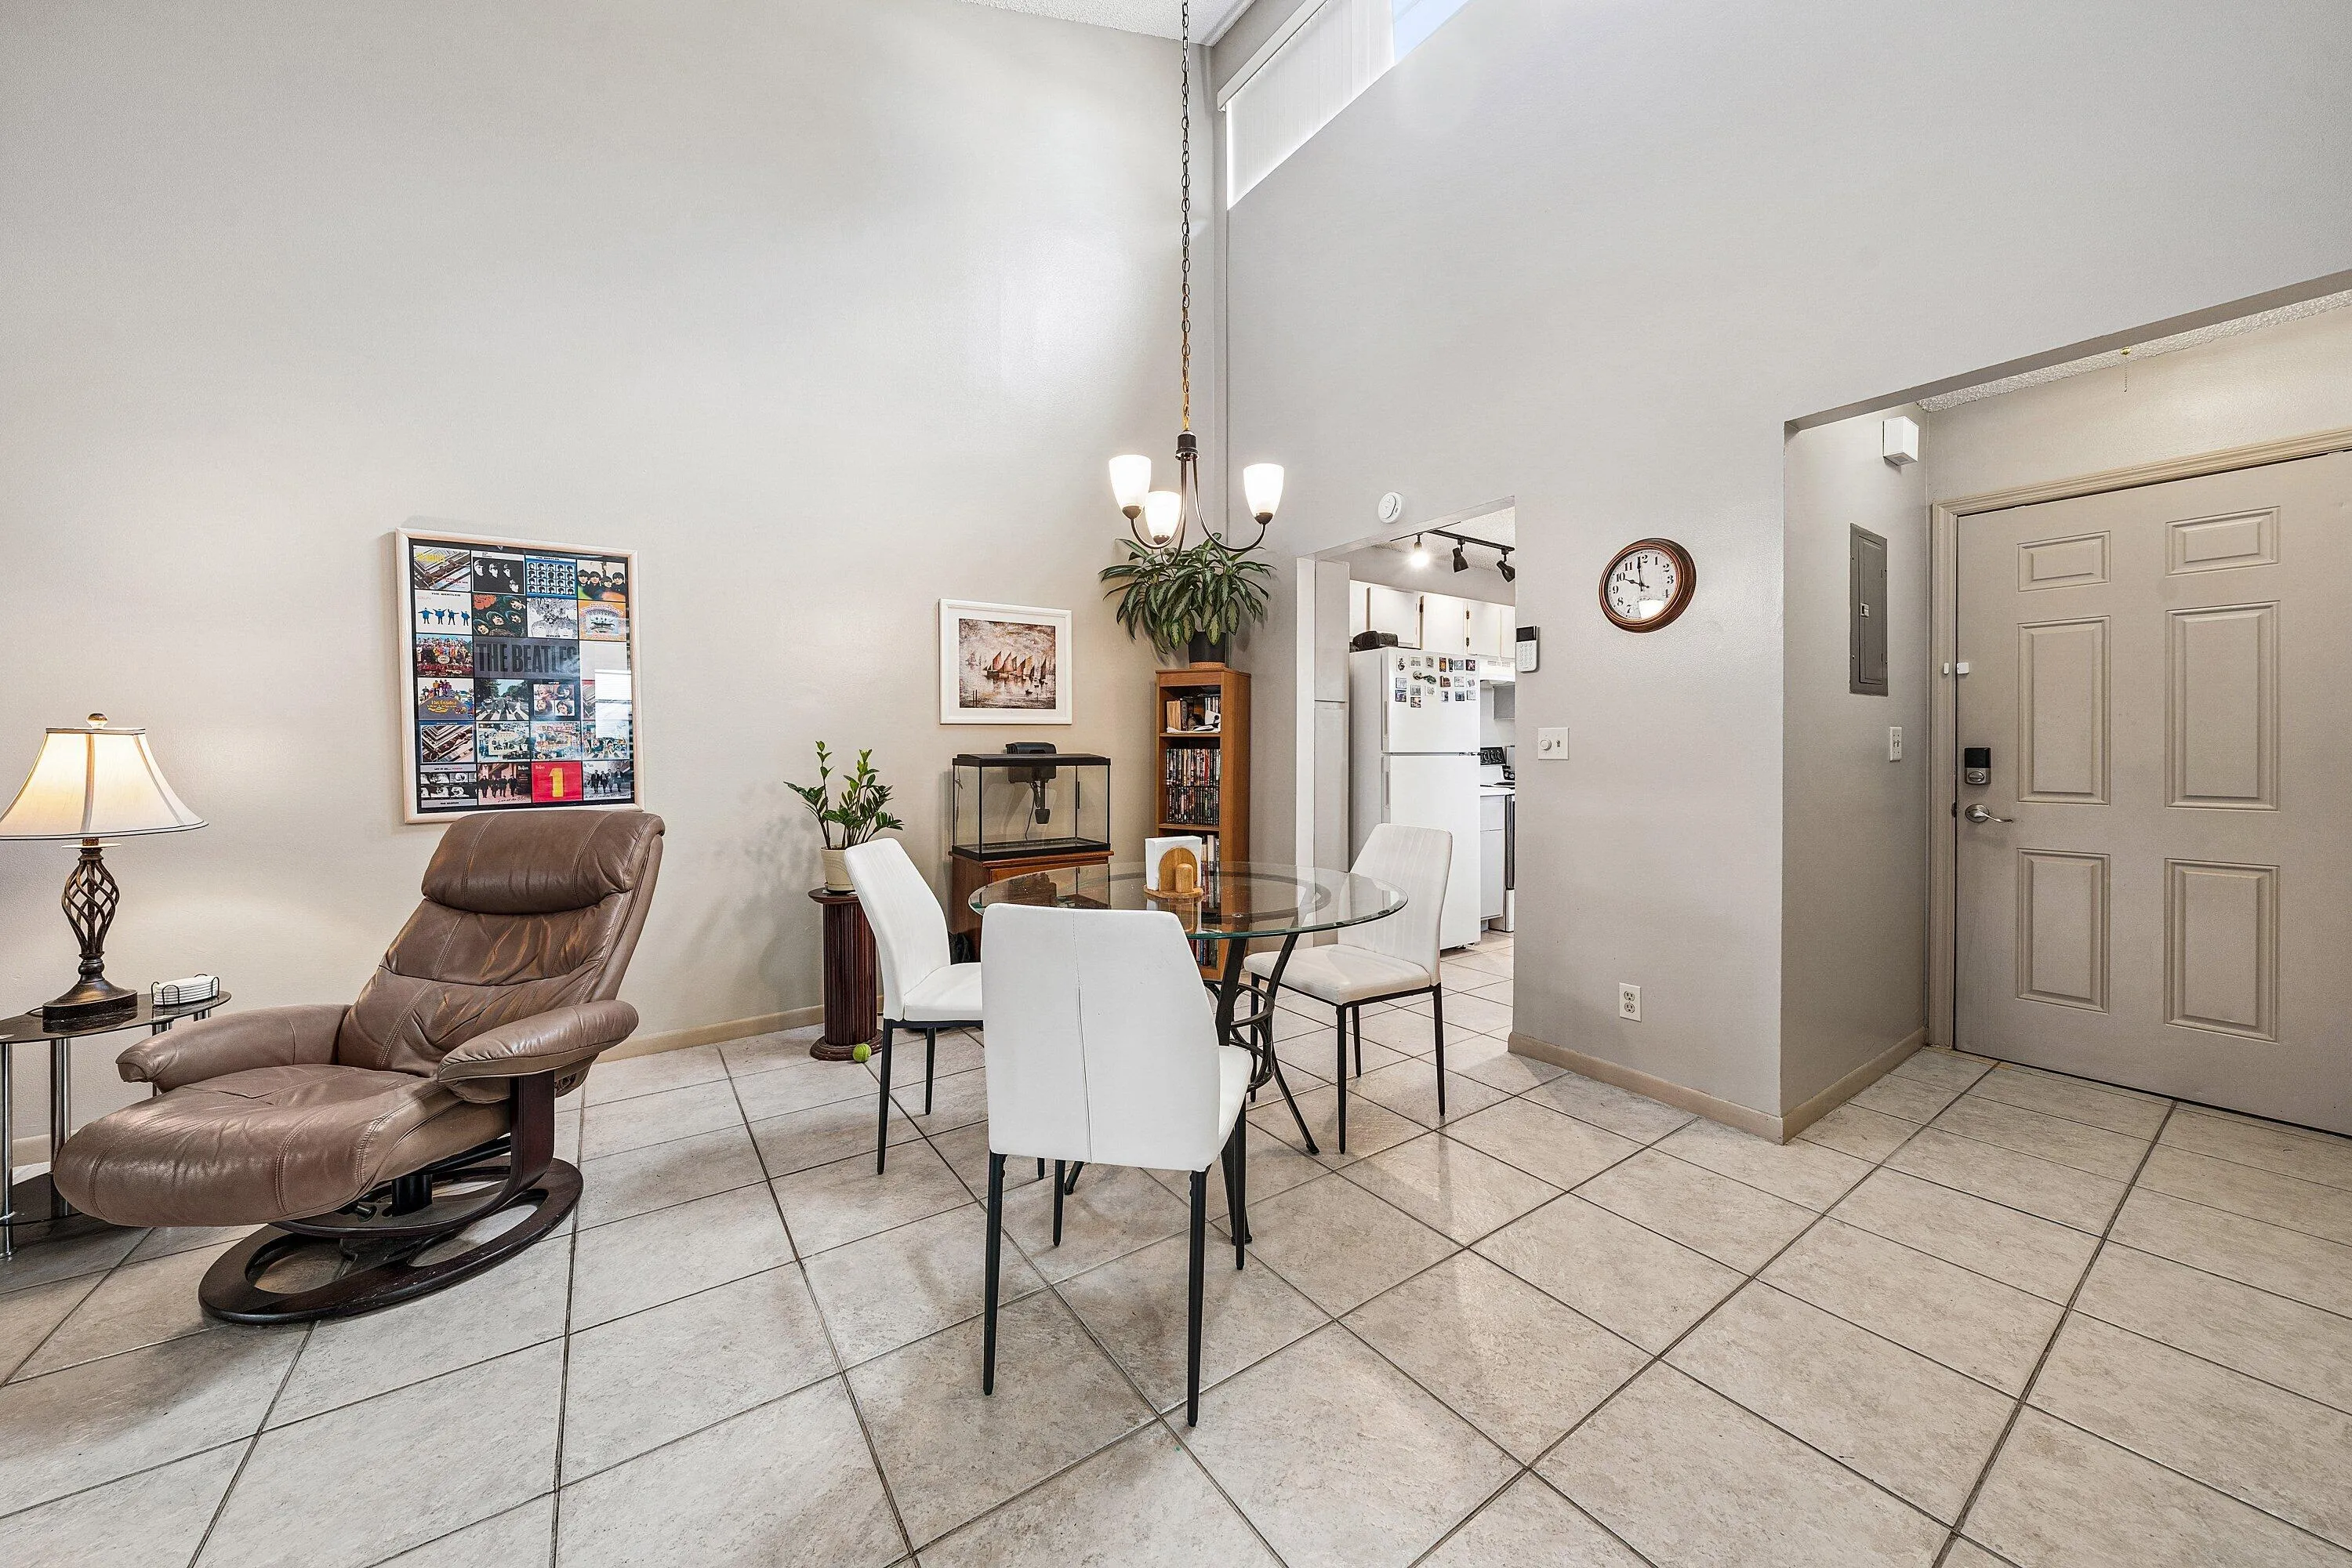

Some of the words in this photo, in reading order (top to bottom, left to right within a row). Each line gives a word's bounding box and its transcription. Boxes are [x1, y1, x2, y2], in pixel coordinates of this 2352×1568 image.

[1637, 555, 1648, 564] 12
[1654, 556, 1658, 565] 1
[1624, 561, 1632, 571] 11
[1663, 564, 1670, 572] 2
[1616, 572, 1625, 582] 10
[1667, 575, 1674, 584] 3
[1613, 586, 1619, 594] 9
[1617, 597, 1624, 606] 8
[1626, 604, 1632, 613] 7
[476, 643, 508, 672] THE
[511, 644, 578, 673] BEATLES
[549, 768, 564, 798] 1
